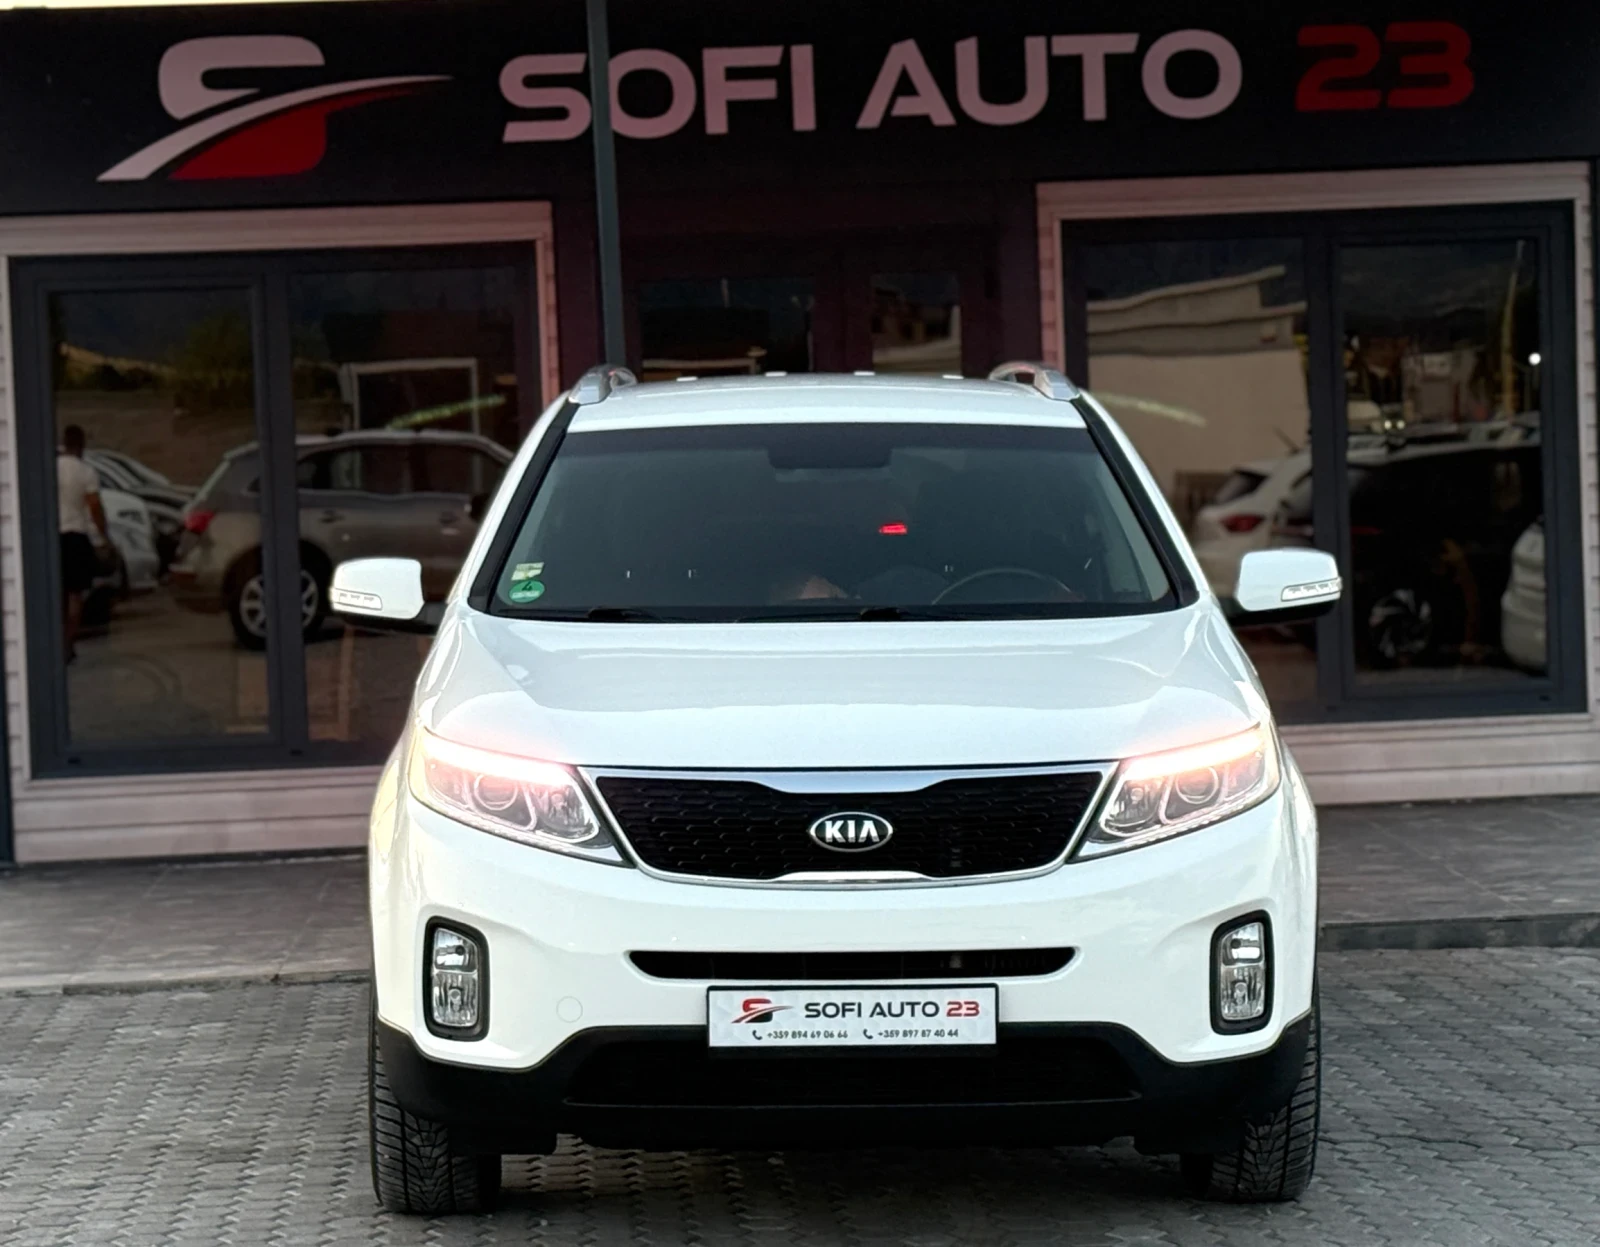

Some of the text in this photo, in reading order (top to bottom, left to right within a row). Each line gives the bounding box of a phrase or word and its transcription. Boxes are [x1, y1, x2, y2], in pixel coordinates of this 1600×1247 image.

[499, 20, 1475, 143] SOFI AUTO 23
[824, 820, 880, 843] KIA
[804, 1000, 981, 1019] SOFI AUTO 23
[767, 1030, 789, 1039] +359
[823, 1030, 835, 1039] 06
[877, 1028, 959, 1038] +359 897 87 40 44
